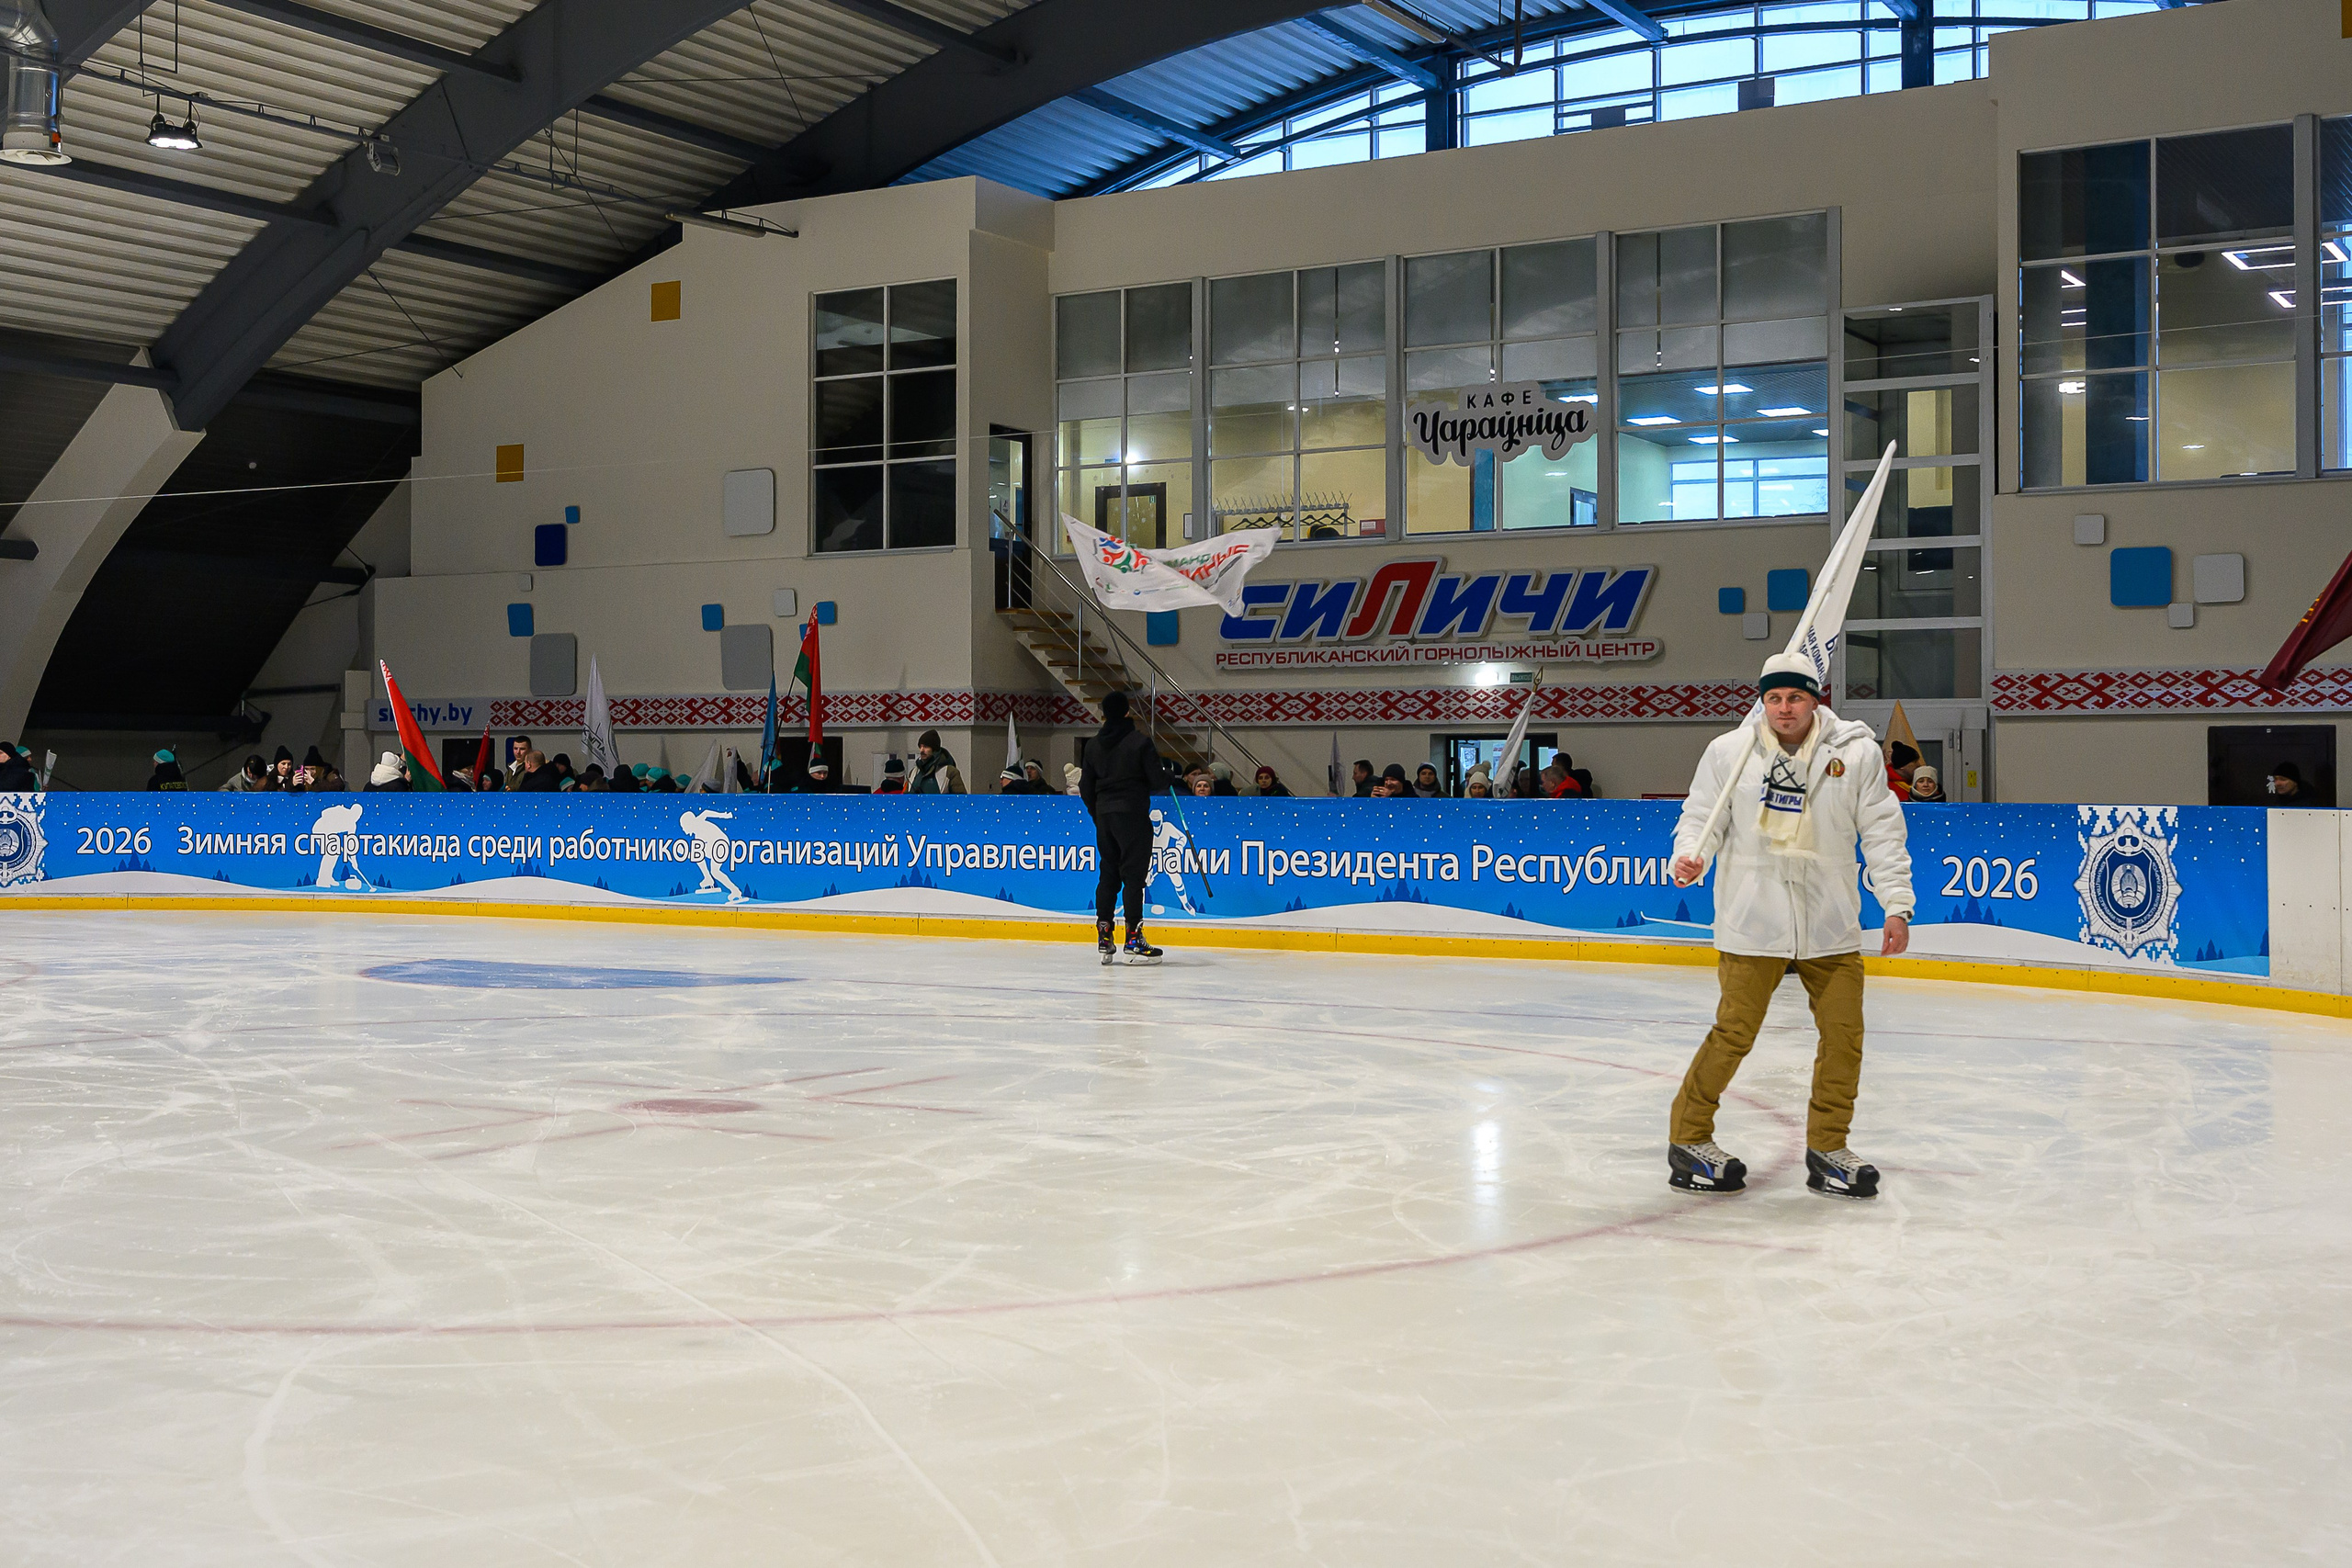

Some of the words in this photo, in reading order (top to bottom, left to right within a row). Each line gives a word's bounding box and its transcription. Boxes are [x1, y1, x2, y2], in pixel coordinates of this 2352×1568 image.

[1466, 389, 1532, 410] КАФЕ
[1412, 407, 1590, 457] Чараўніца
[1216, 645, 1410, 666] РЕСПУБЛИКАНСКИЙ
[1413, 640, 1582, 662] ГОРНОЛЫЖНЫЙ
[1587, 640, 1656, 660] ЦЕНТР
[1775, 793, 1803, 807] ТИГРЫ
[76, 827, 152, 855] 2026
[177, 826, 285, 856] Зимняя
[294, 831, 462, 866] спартакиада
[467, 832, 542, 865] среди
[548, 828, 706, 866] работников
[711, 832, 899, 872] организаций
[907, 835, 1096, 877] Управления
[1240, 840, 1459, 886] Президента
[1940, 855, 2040, 901] 2026
